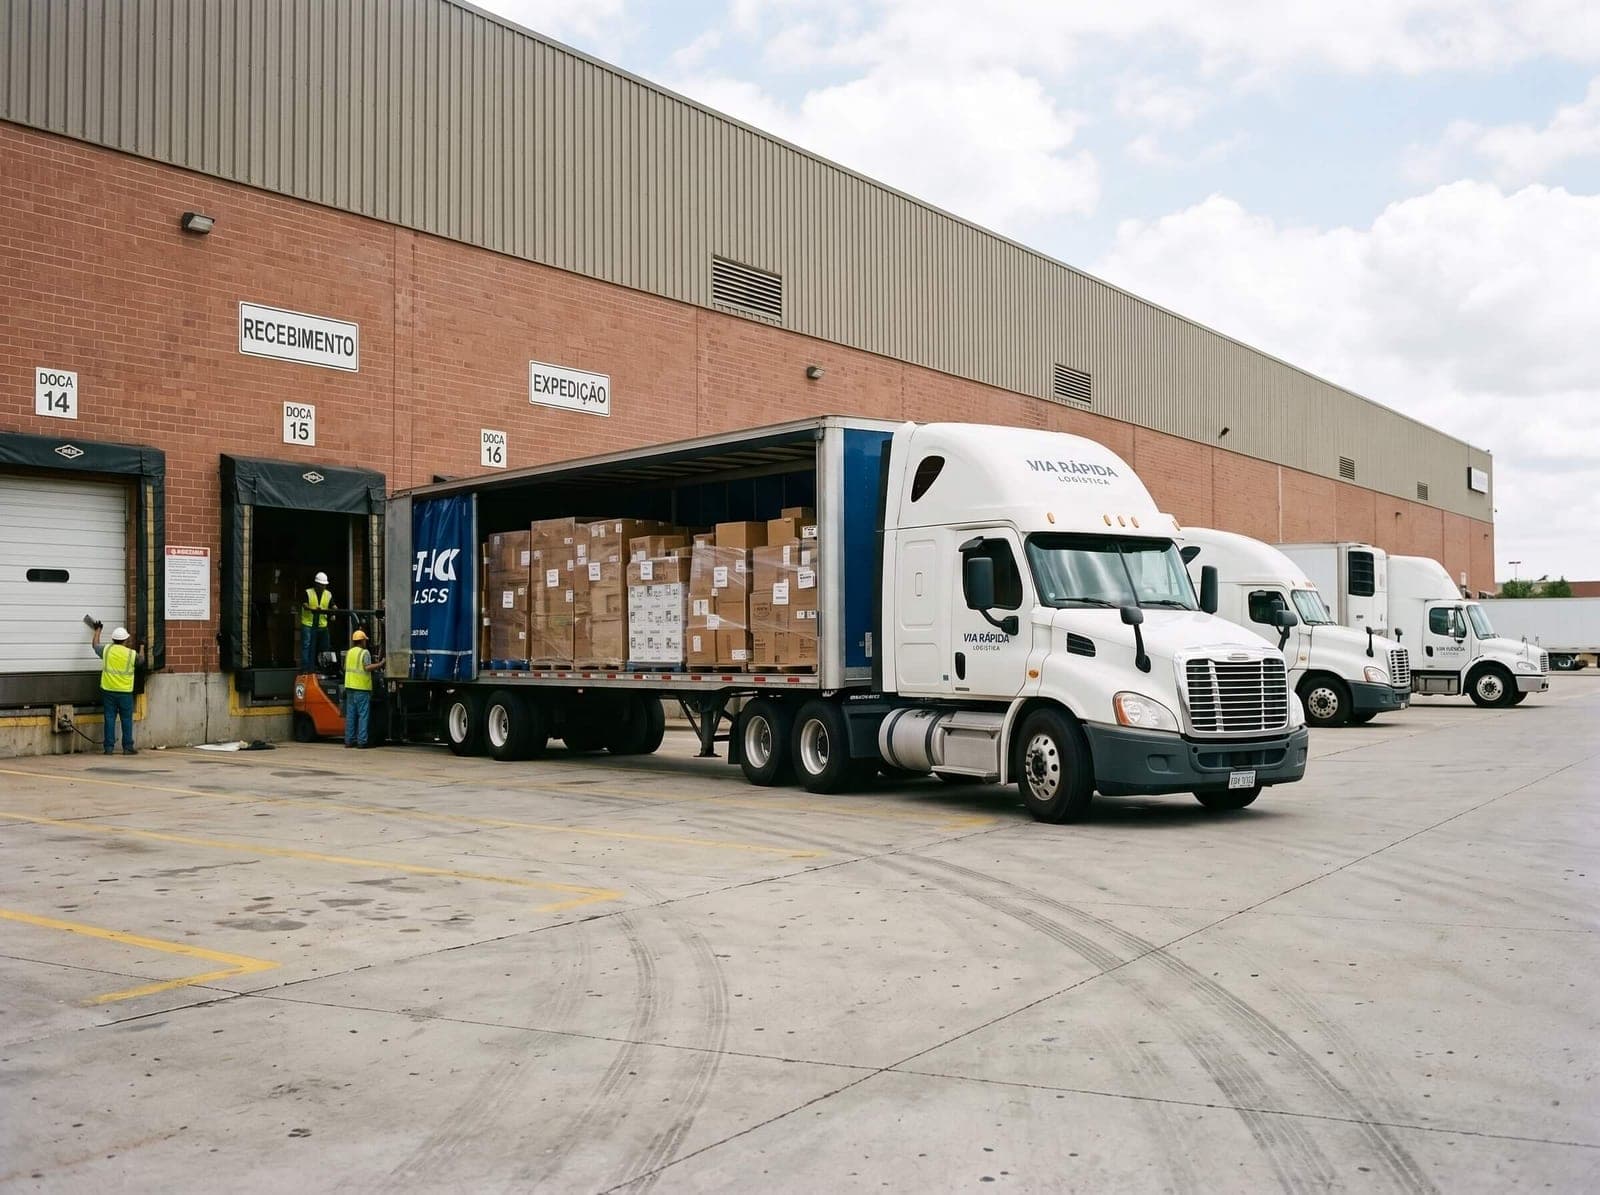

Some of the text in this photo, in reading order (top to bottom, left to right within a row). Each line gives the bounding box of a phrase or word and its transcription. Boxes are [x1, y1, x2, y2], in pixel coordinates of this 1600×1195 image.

[243, 317, 355, 357] RECEBIMENTO
[39, 372, 74, 389] DOCA
[533, 373, 607, 405] EXPEDIÇÃO
[43, 390, 70, 413] 14
[286, 406, 313, 420] DOCA
[289, 421, 309, 441] 15
[483, 432, 505, 445] DOCA
[486, 446, 502, 464] 16
[1026, 459, 1119, 478] VIA RÁPIDA
[963, 631, 1010, 643] VIA RÁPIDA
